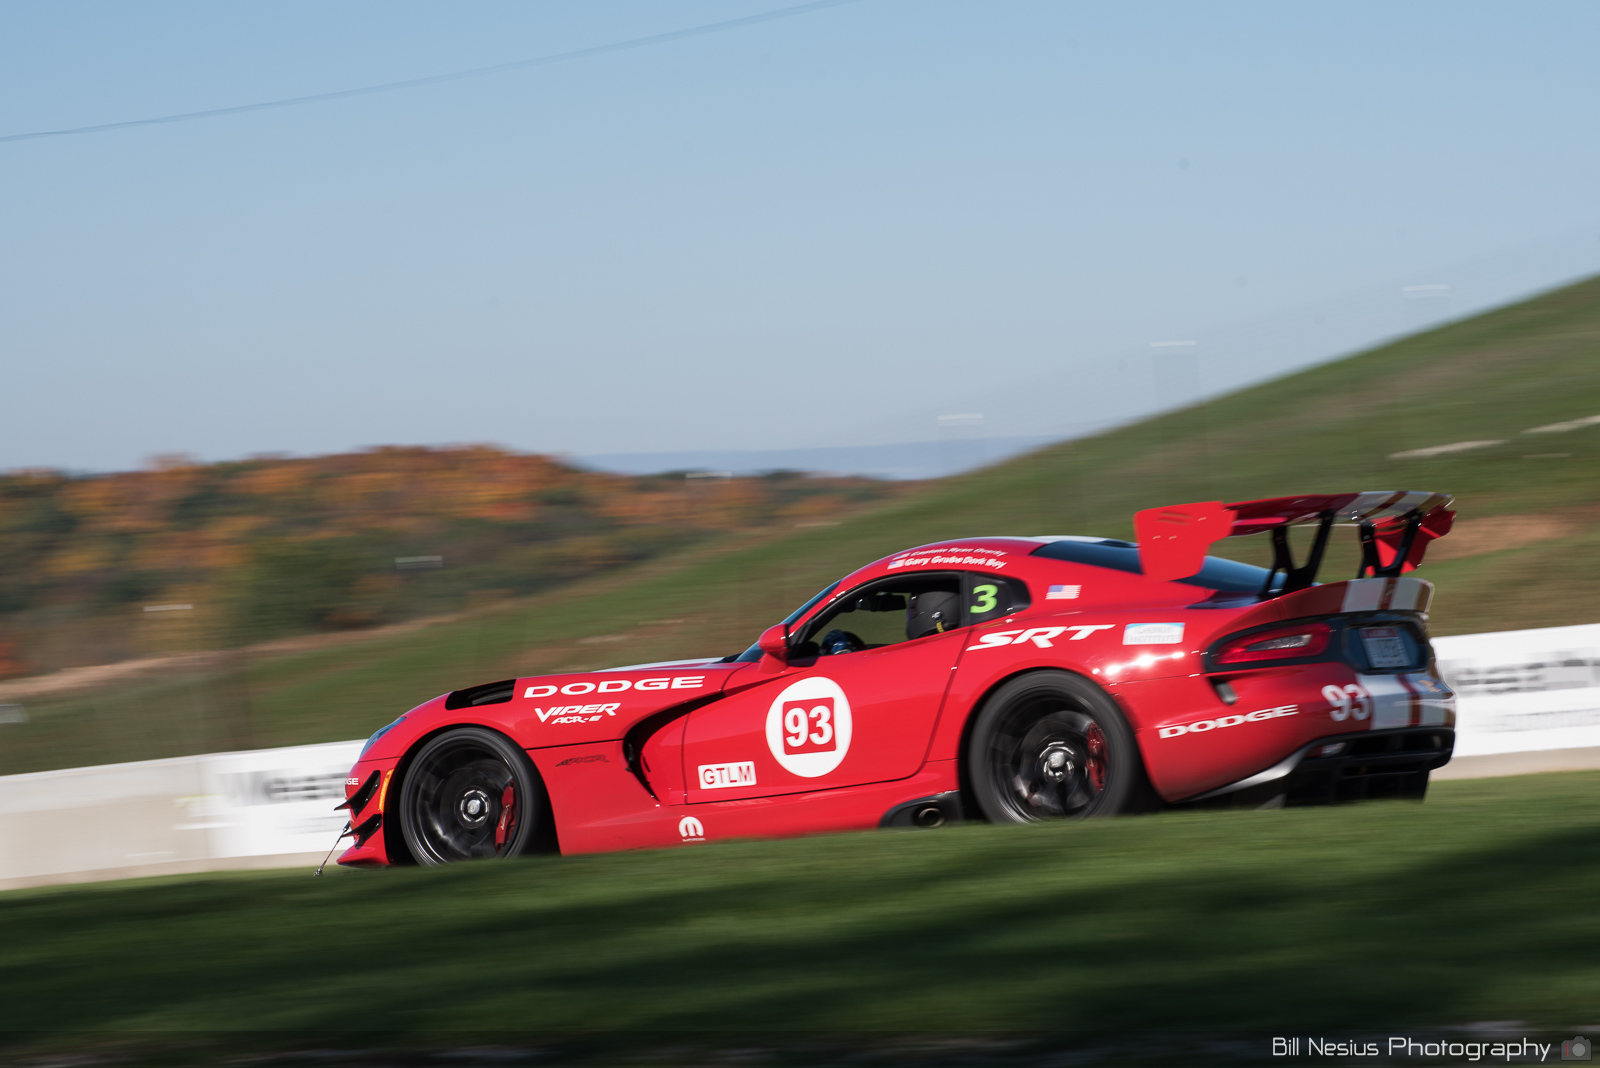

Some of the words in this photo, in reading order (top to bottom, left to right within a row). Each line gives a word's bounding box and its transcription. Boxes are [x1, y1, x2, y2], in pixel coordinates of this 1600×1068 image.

[970, 584, 998, 614] 3
[965, 624, 1117, 652] SRT
[523, 676, 706, 699] DODGE
[534, 702, 622, 723] VIPER
[1321, 683, 1371, 721] 93
[551, 715, 603, 725] ACR-E
[784, 705, 833, 748] 93
[1158, 704, 1299, 739] DODGE
[703, 765, 753, 785] GTLM
